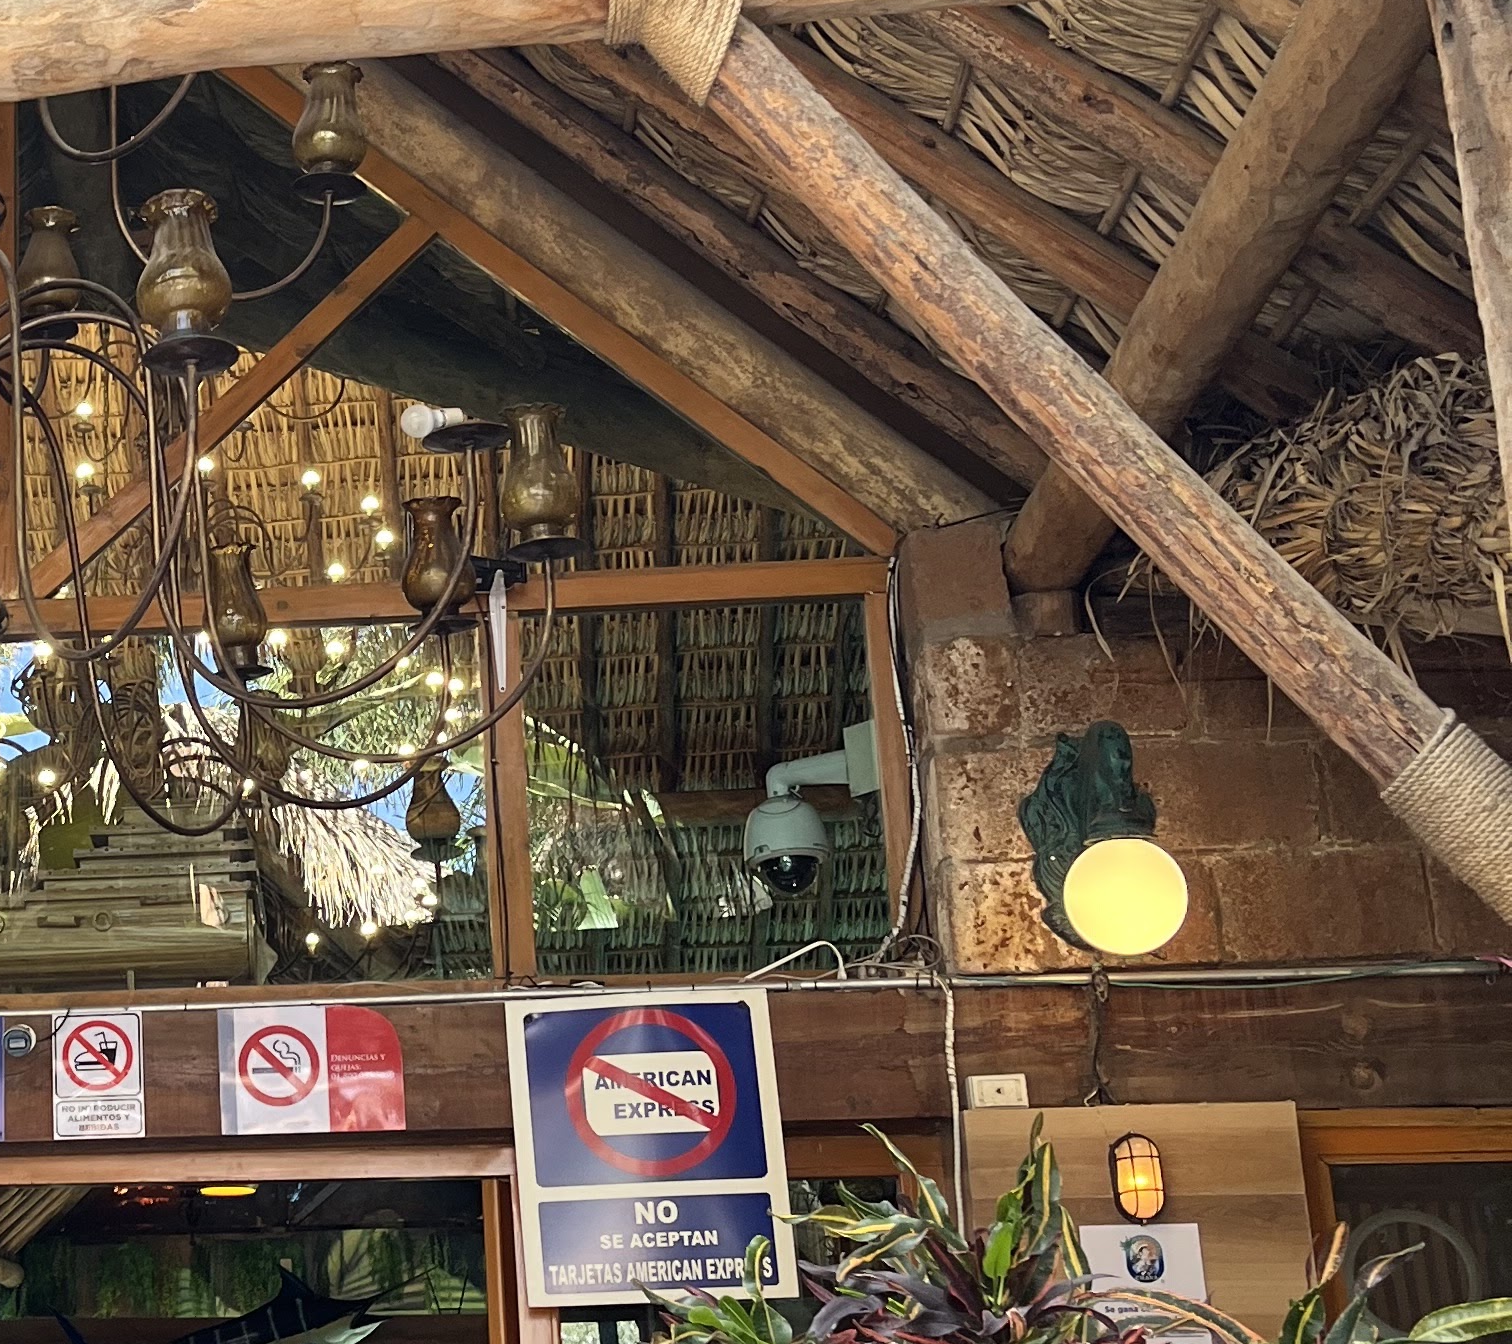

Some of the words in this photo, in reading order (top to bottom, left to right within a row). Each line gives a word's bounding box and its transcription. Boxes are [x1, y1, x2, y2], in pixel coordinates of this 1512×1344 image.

[379, 1053, 386, 1061] Y
[61, 1105, 76, 1113] NO
[613, 1099, 715, 1120] EXPRS
[67, 1113, 122, 1123] ALIMENTOS
[124, 1113, 130, 1121] Y
[634, 1200, 678, 1224] NO
[600, 1233, 624, 1249] SE
[630, 1229, 719, 1248] ACEPTAN
[549, 1263, 623, 1286] TARJETAS
[626, 1259, 703, 1284] AMERICAN
[706, 1256, 774, 1280] EXPRS
[1105, 1305, 1116, 1314] Se
